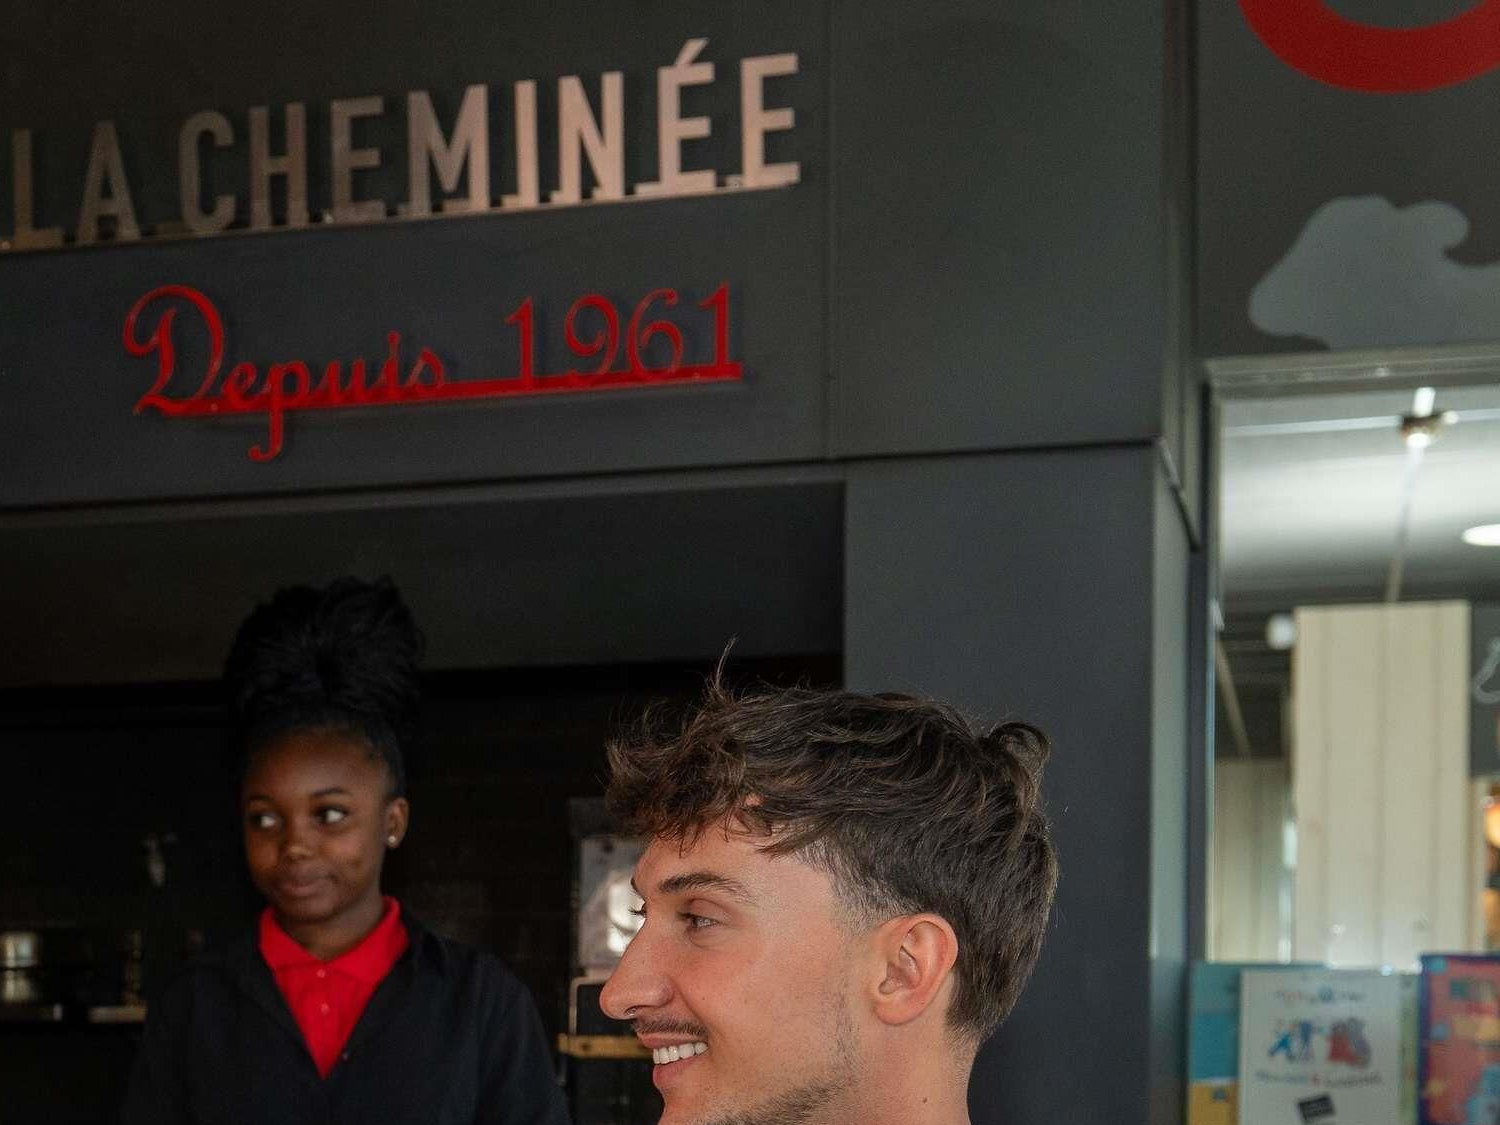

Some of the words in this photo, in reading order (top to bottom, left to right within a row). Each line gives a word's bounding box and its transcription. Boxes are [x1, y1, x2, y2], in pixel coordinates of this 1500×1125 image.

[11, 120, 143, 251] LA
[178, 38, 800, 237] CHEMINÉE
[122, 284, 446, 462] Depuis
[505, 282, 742, 388] 1961
